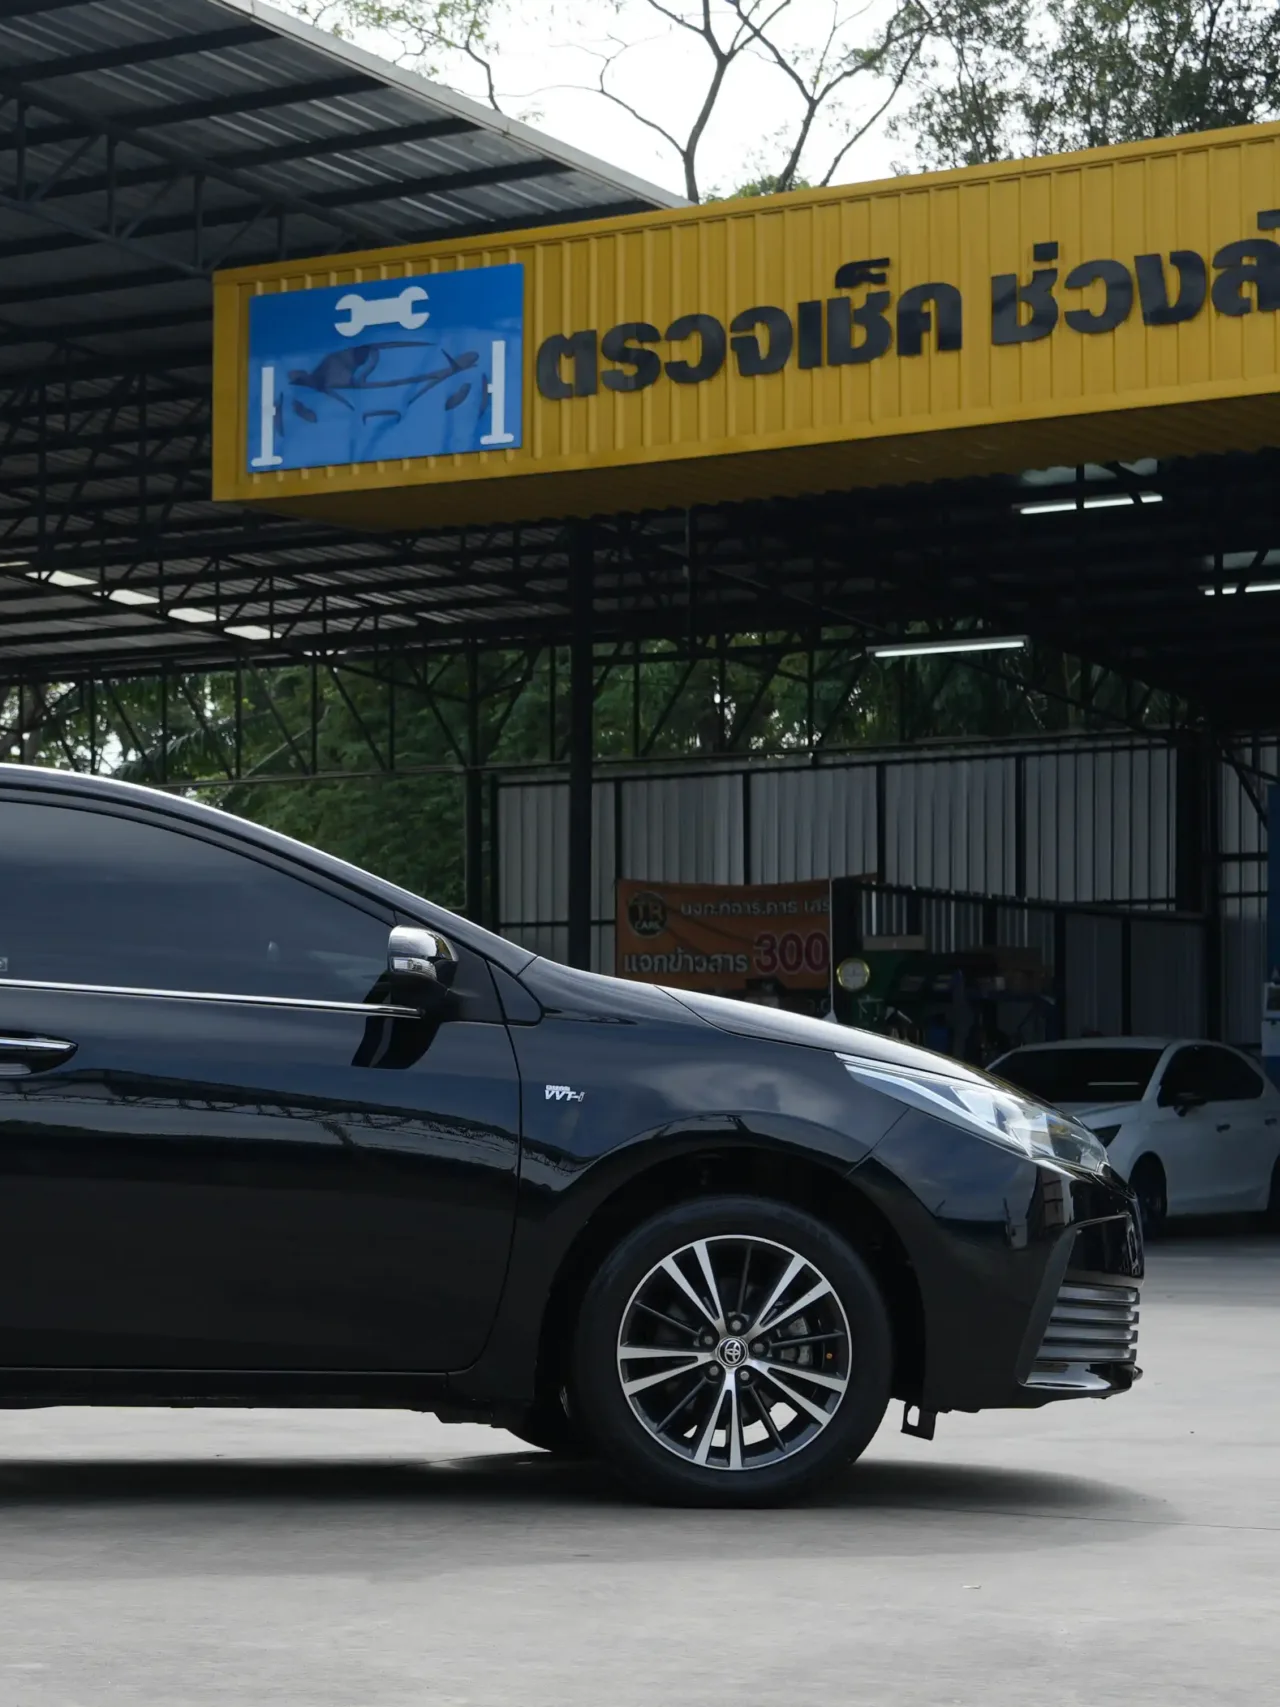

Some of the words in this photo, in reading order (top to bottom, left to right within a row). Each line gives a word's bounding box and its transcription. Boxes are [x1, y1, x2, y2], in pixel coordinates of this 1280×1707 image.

[536, 257, 963, 400] ตรวจเช็ค
[625, 947, 748, 973] แจกข้าวสาร
[753, 931, 830, 975] 300
